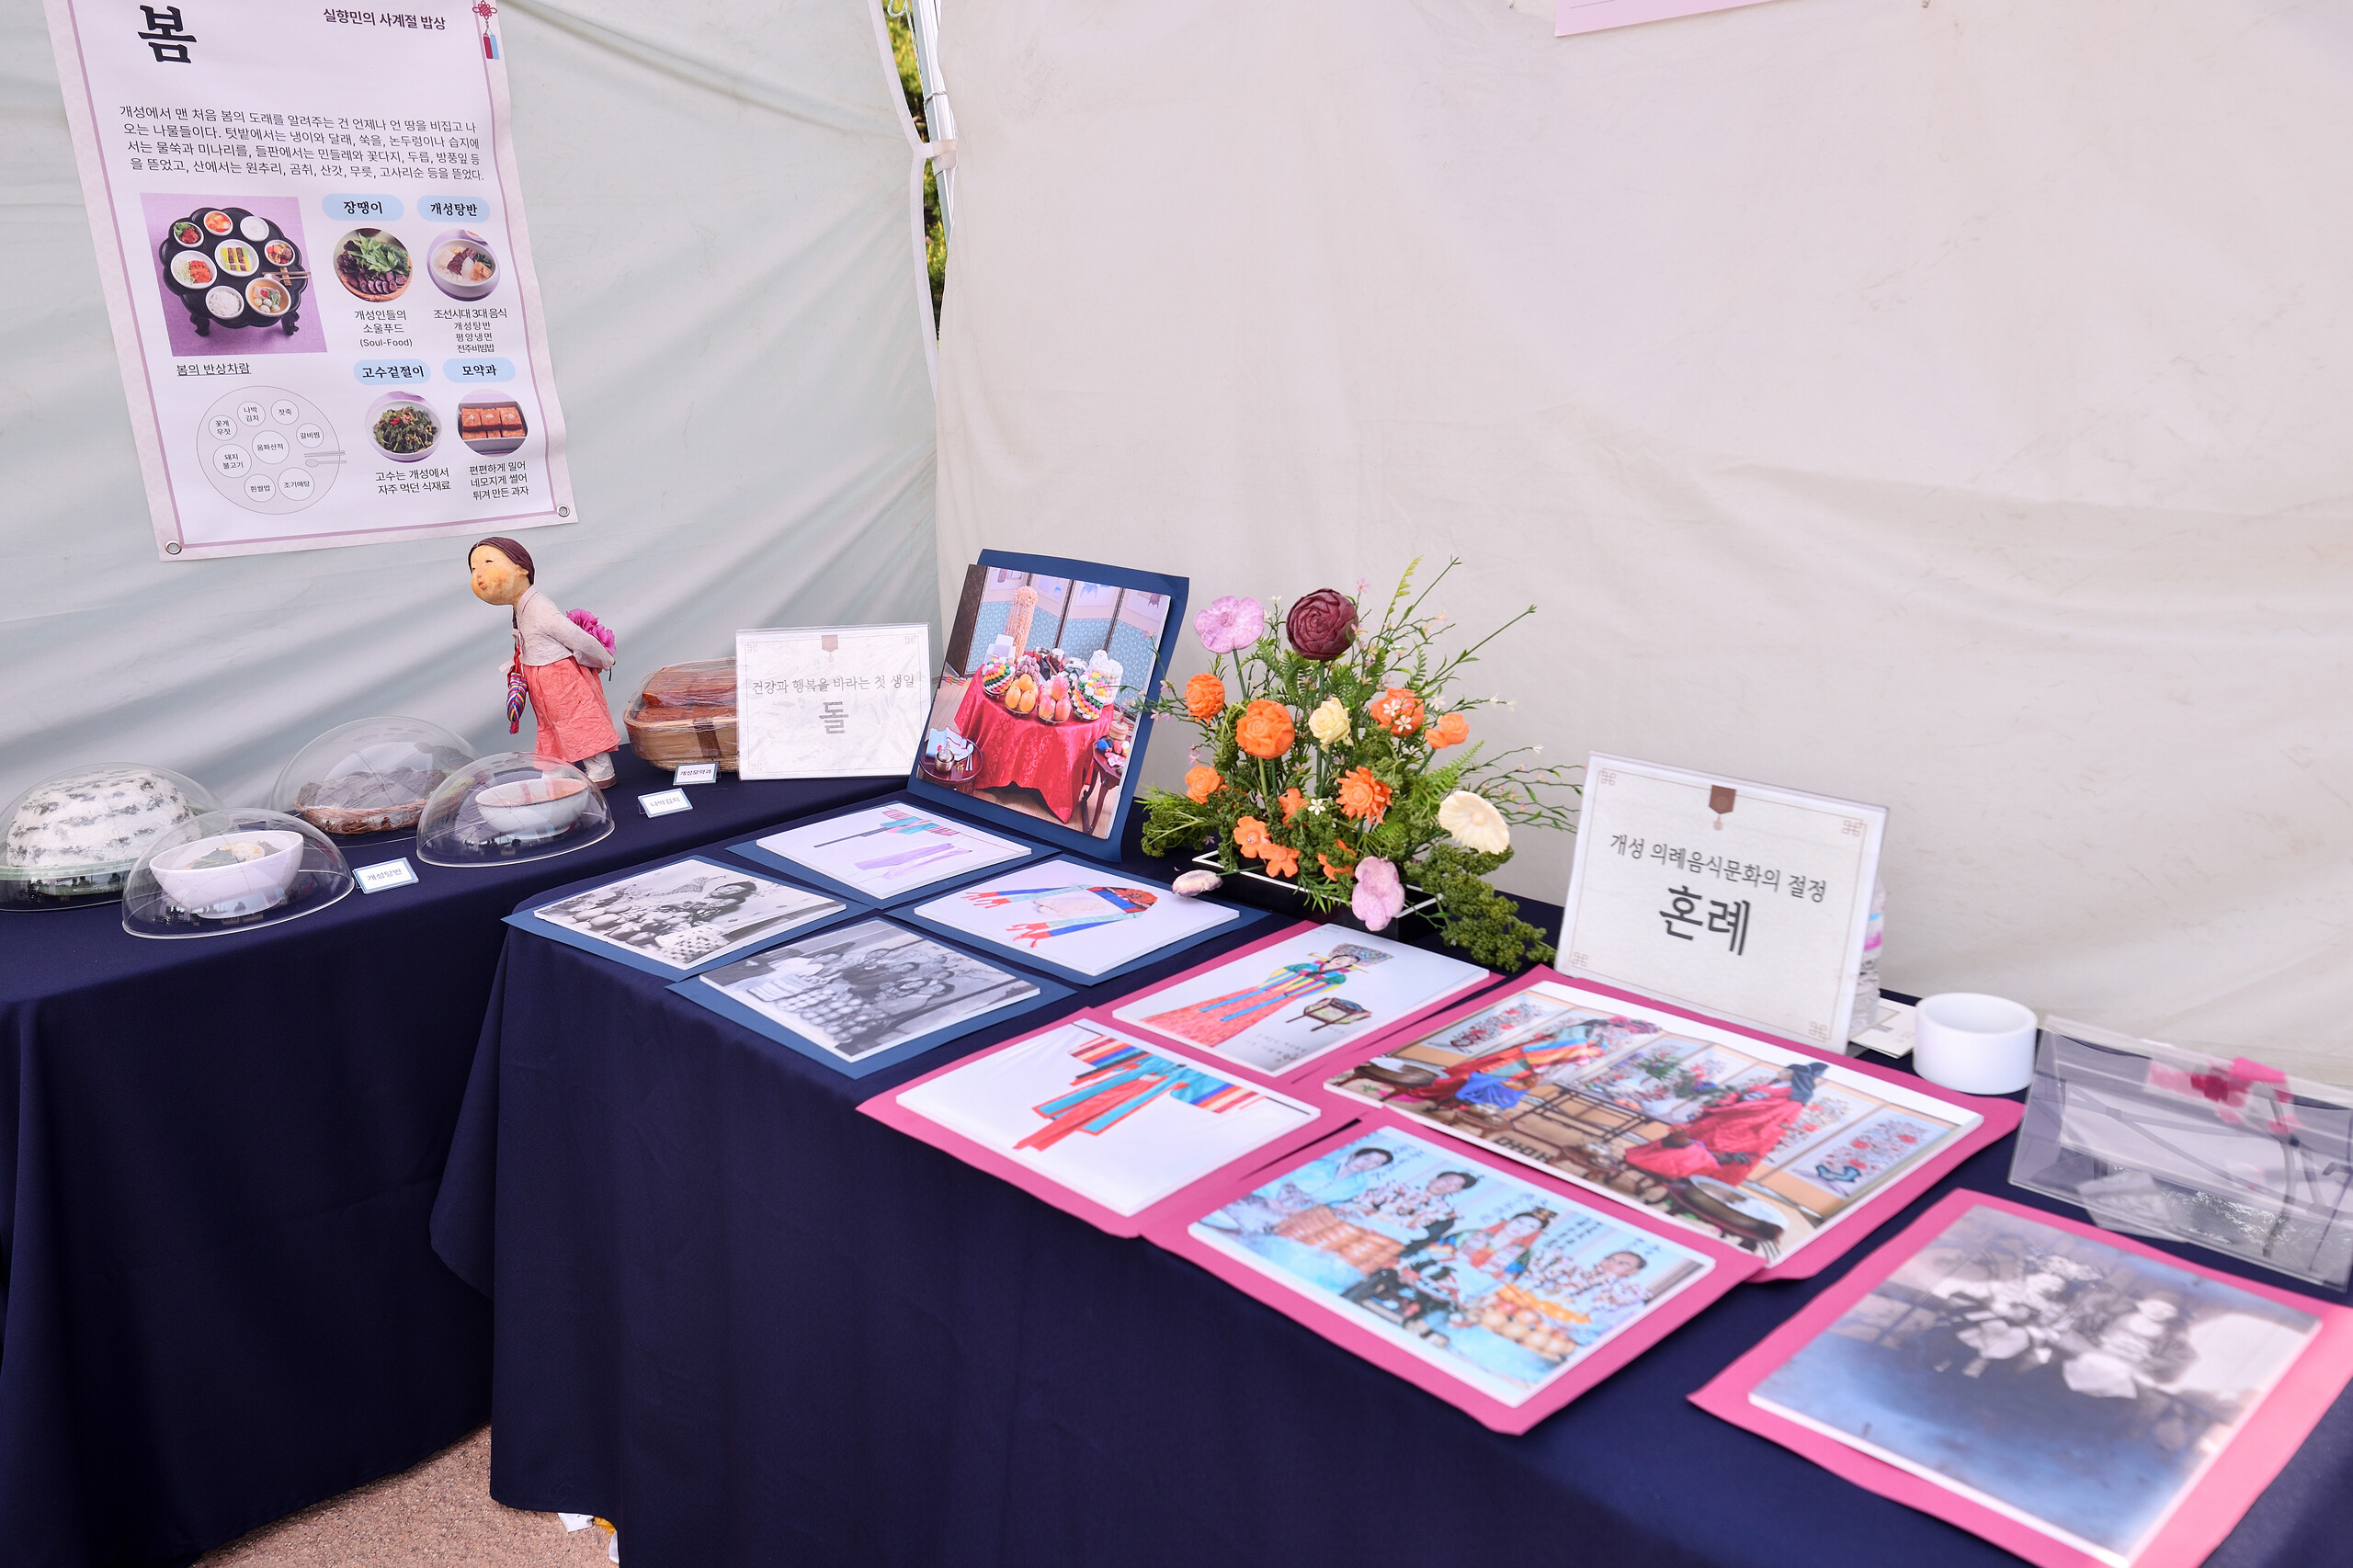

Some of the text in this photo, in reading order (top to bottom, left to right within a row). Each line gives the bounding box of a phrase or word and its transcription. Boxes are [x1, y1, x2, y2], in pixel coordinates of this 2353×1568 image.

[323, 7, 446, 31] 실향민의 사계절 밥상
[137, 4, 197, 63] 봄
[119, 106, 476, 133] 개성에서 맨 처음 봄의 도래를 알려주는 건 언제나 언 땅을 비집고 나
[123, 123, 480, 150] 오는 나물들이다. 텃밭에서는 냉이와 달래, 쑥을, 논두렁이나 습지에
[128, 141, 153, 153] 서는
[156, 142, 194, 155] 물쑥과
[198, 143, 252, 158] 미나리를,
[256, 145, 314, 159] 들판에서는
[318, 148, 363, 162] 민들레와
[368, 151, 404, 164] 꽃다지,
[471, 153, 480, 165] 등
[131, 157, 143, 171] 을
[193, 160, 242, 174] 산에서는
[246, 162, 286, 176] 원추리,
[290, 163, 317, 177] 곰취,
[321, 165, 347, 178] 산갓,
[350, 165, 376, 179] 무릇,
[380, 166, 425, 179] 고사리순
[427, 167, 449, 179] 등을
[344, 200, 383, 215] 장땡이
[430, 202, 478, 217] 개성탕반
[355, 310, 407, 321] 개성인들의
[434, 308, 471, 320] 조선시대
[489, 308, 507, 319] 음식
[363, 324, 404, 334] 소울푸드
[454, 322, 491, 331] 개성탕반
[359, 338, 413, 348] (Soul-Food)
[456, 332, 493, 343] 평양냉면
[176, 363, 200, 377] 봄의
[362, 365, 425, 379] 고수겉절이
[462, 364, 497, 377] 모약과
[508, 460, 527, 472] 밀어
[376, 467, 449, 483] 고수는 개성에서
[471, 473, 528, 488] 네모지게 썰어
[378, 481, 451, 495] 자주 먹던 식재료
[472, 485, 529, 501] 튀겨 만든 과자
[752, 673, 915, 695] 건강과 행복을 바라는 첫 생일
[818, 701, 849, 734] 돌
[1609, 833, 1827, 903] 개성 의례음식문화의 절정
[1659, 884, 1751, 957] 혼례
